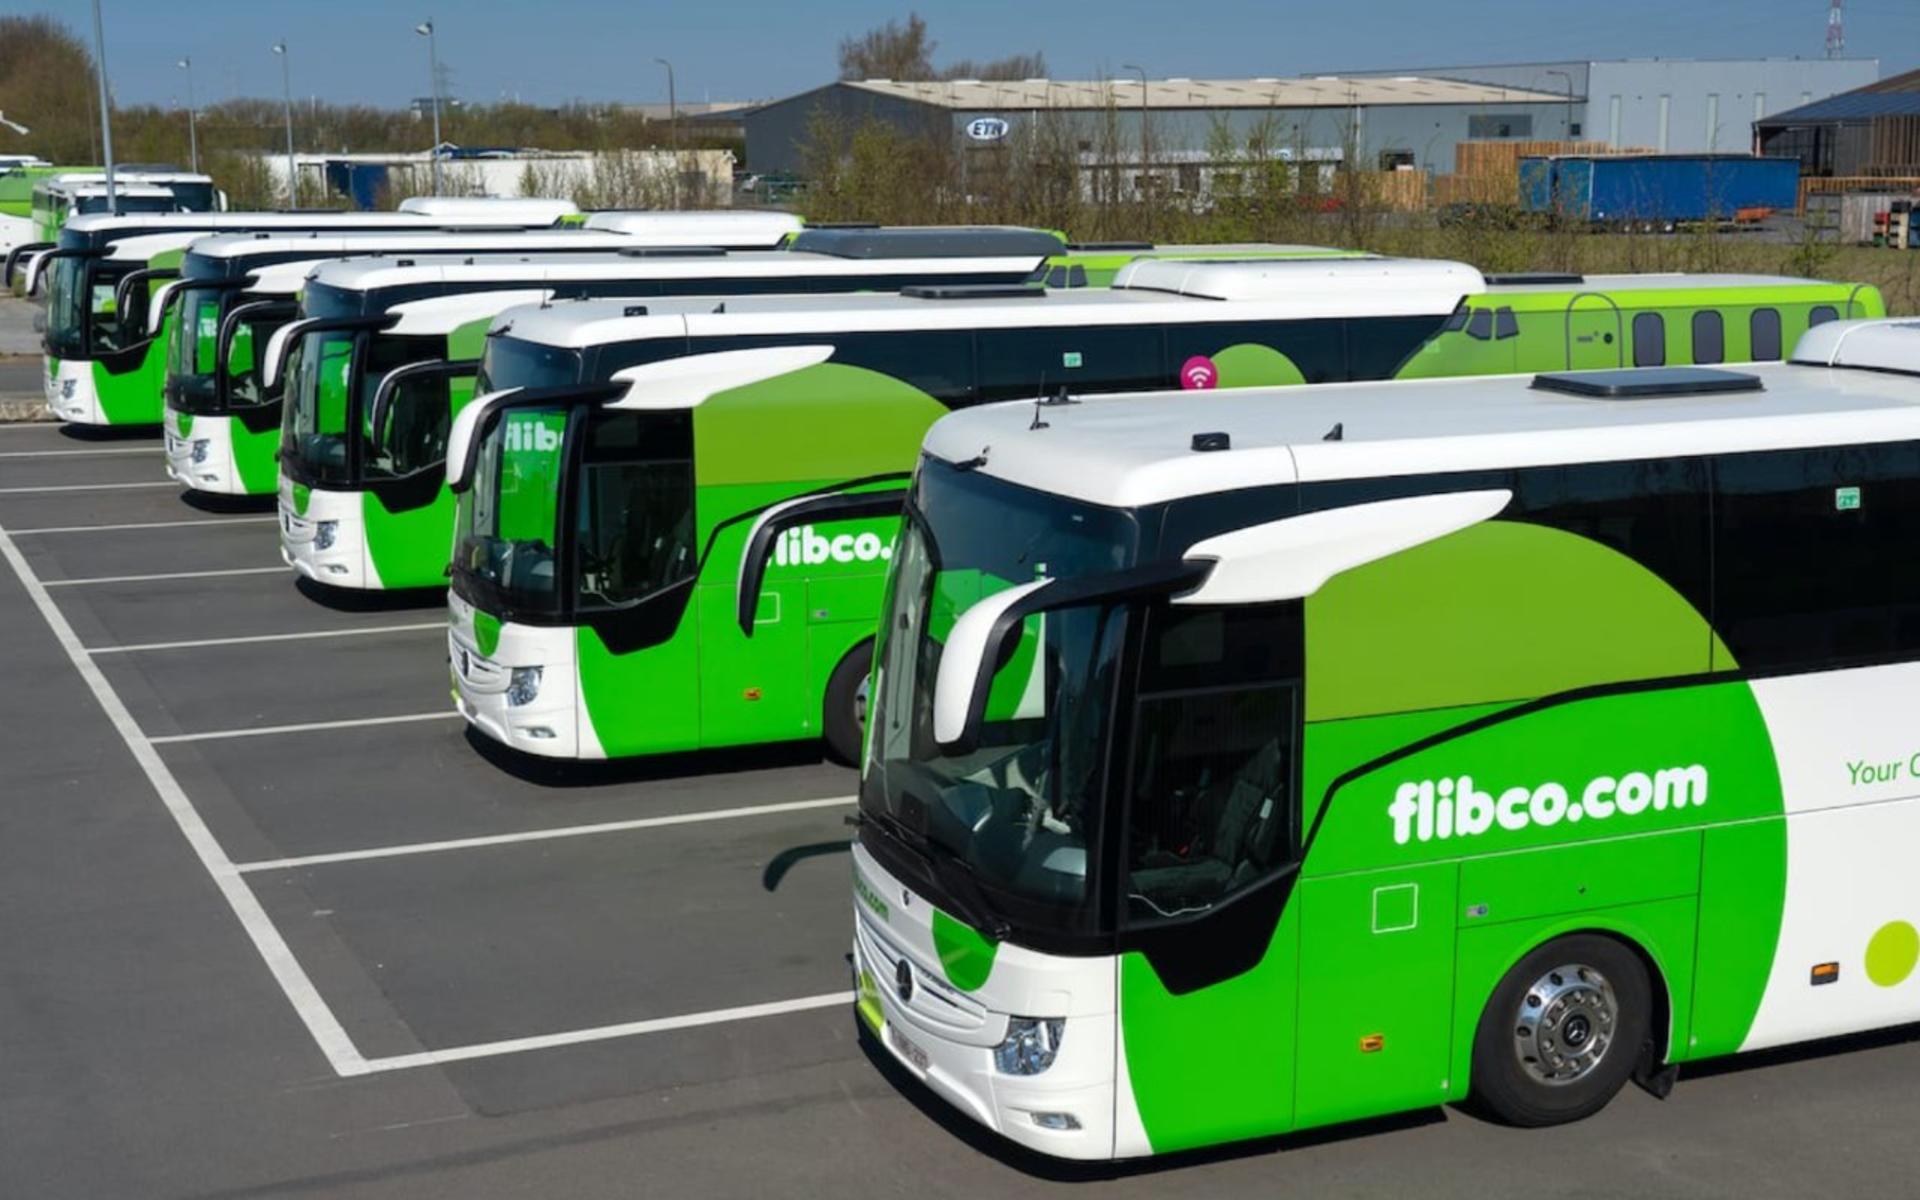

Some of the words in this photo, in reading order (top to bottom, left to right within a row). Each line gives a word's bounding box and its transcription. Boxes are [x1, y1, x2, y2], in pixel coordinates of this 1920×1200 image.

[766, 525, 897, 567] libco.
[1846, 759, 1903, 785] Your
[1388, 764, 1708, 845] flibco.com
